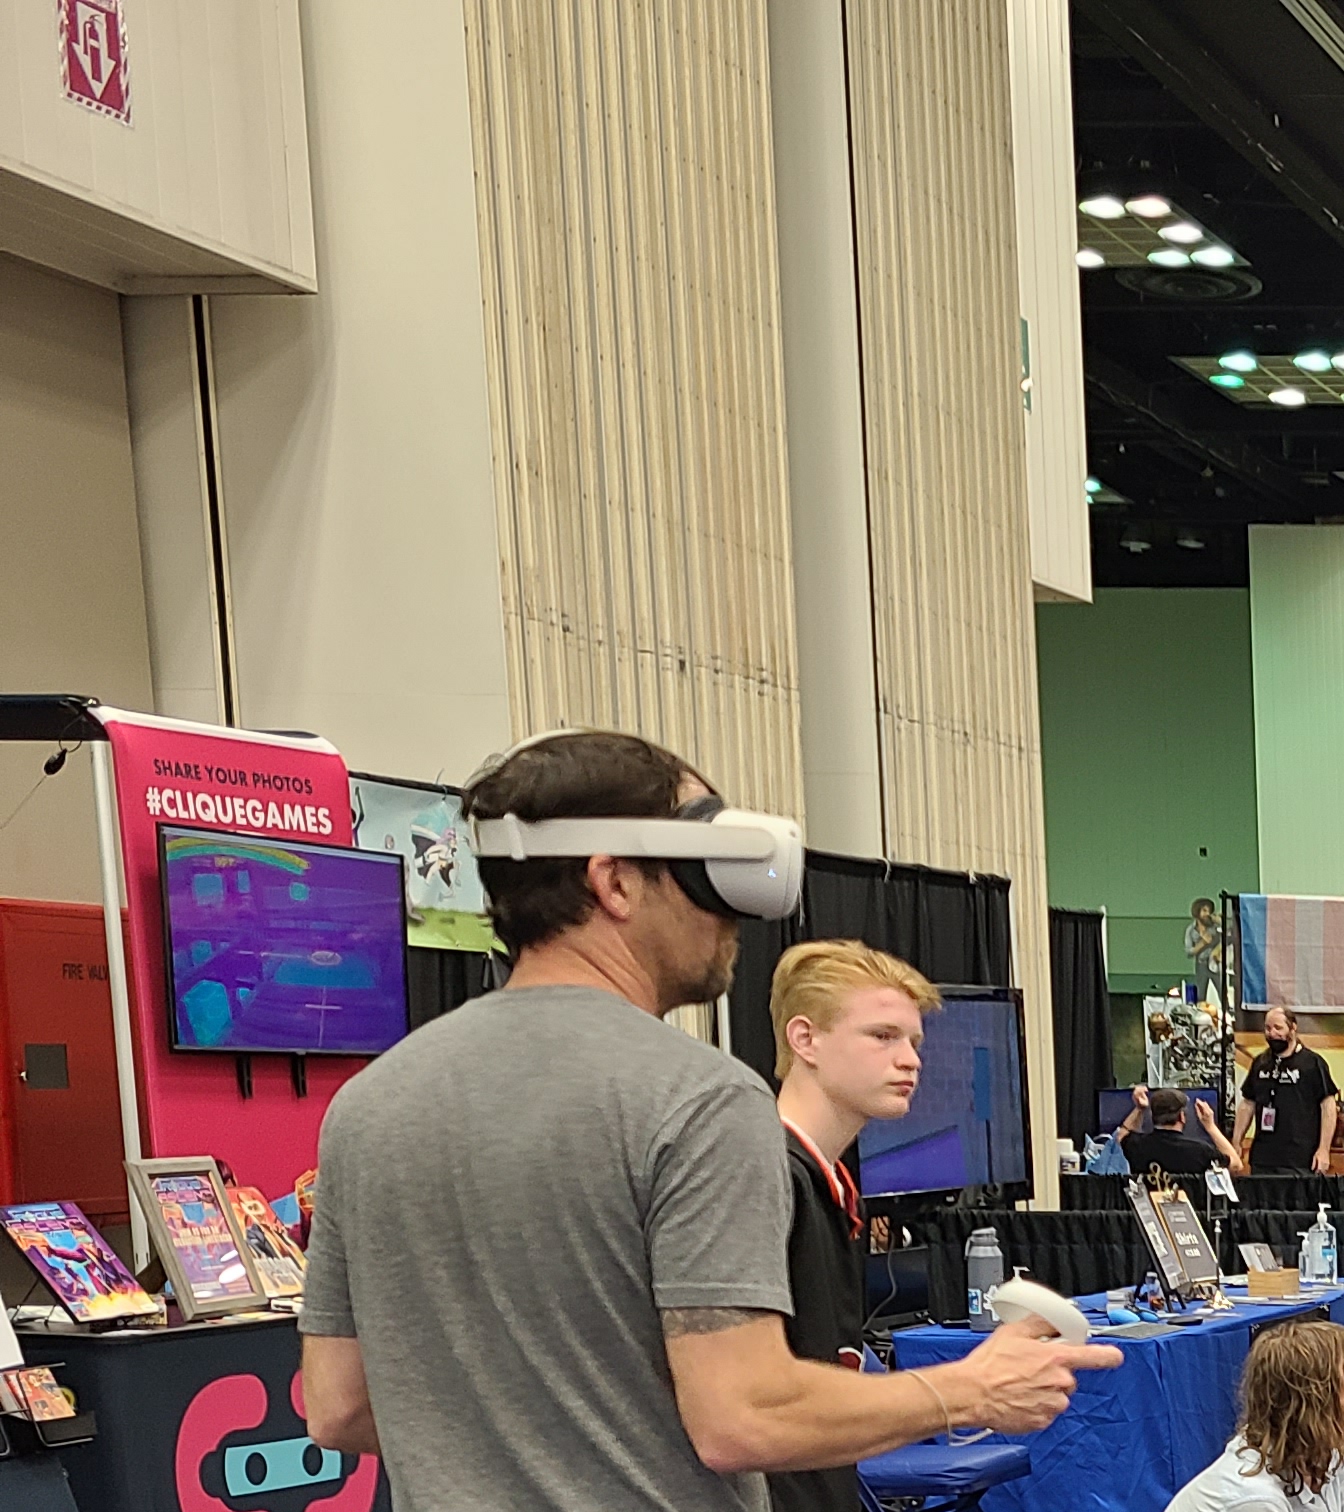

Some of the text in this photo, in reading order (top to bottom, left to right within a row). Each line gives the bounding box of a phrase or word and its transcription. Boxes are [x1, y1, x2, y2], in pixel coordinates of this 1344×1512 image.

[154, 758, 313, 795] SHARE YOUR PHOTOS
[146, 786, 333, 835] #CLIQUEGAMES
[62, 963, 83, 980] FIRE
